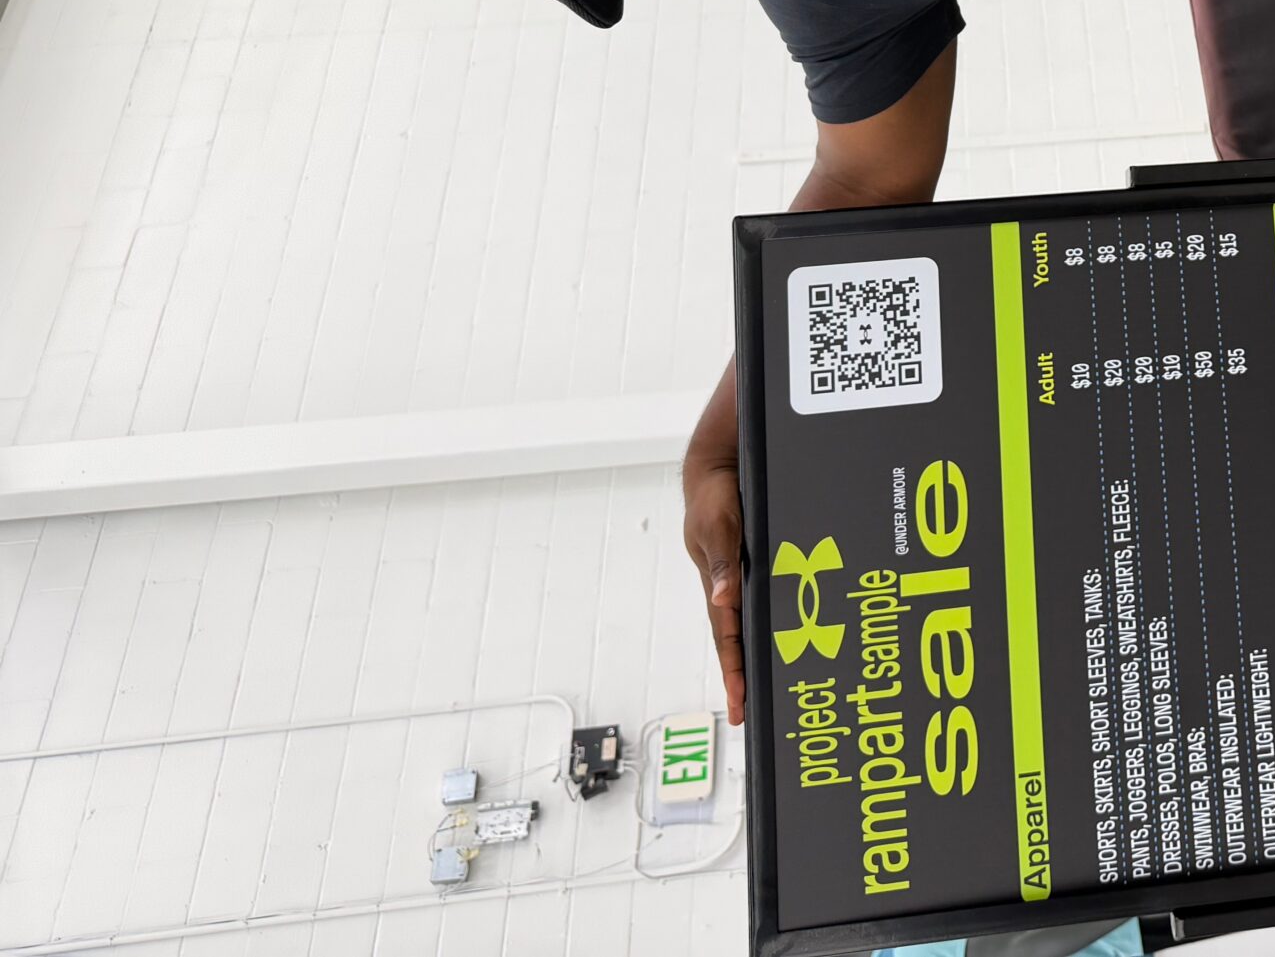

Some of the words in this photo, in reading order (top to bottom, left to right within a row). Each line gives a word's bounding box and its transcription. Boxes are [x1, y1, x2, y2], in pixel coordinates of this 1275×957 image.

[1032, 232, 1049, 288] Youth
[1064, 248, 1086, 266] $8
[1097, 246, 1117, 263] $8
[1127, 243, 1148, 261] $8
[1154, 242, 1175, 258] $5
[1186, 234, 1206, 260] $20
[1219, 233, 1239, 256] $15
[1038, 352, 1055, 405] Adult
[1070, 363, 1092, 389] $10
[1103, 360, 1124, 386] $20
[1134, 356, 1155, 384] $20
[1162, 355, 1183, 380] $10
[1194, 351, 1215, 378] $50
[1227, 348, 1248, 374] $35
[892, 467, 906, 510] ARMOUR
[1110, 480, 1131, 542] FLEECE:
[894, 512, 909, 555] @UNDER
[1083, 568, 1103, 622] TANKS:
[1114, 545, 1138, 654] SWEATSHIRTS,
[847, 570, 911, 678] sample
[900, 460, 978, 796] sale
[1086, 623, 1107, 696] SLEEVES,
[1149, 616, 1170, 689] SLEEVES:
[1090, 701, 1110, 752] SHORT
[1120, 657, 1144, 741] LEGGINGS,
[1154, 694, 1174, 735] LONG
[1216, 674, 1240, 764] INSULATED:
[1250, 648, 1275, 758] LIGHTWEIGHT:
[662, 727, 709, 785] EXIT
[786, 678, 852, 787] project
[1187, 726, 1208, 774] BRAS:
[846, 680, 921, 895] rampart
[1094, 755, 1115, 813] SKIRTS,
[1126, 744, 1148, 822] JOGGERS,
[1156, 738, 1178, 794] POLOS,
[1018, 771, 1050, 890] Apparel
[1160, 796, 1182, 874] DRESSES,
[1190, 776, 1214, 869] SWIMWEAR,
[1222, 767, 1246, 864] OUTERWEAR
[1097, 816, 1118, 882] SHORTS,
[1130, 824, 1152, 878] PANTS,
